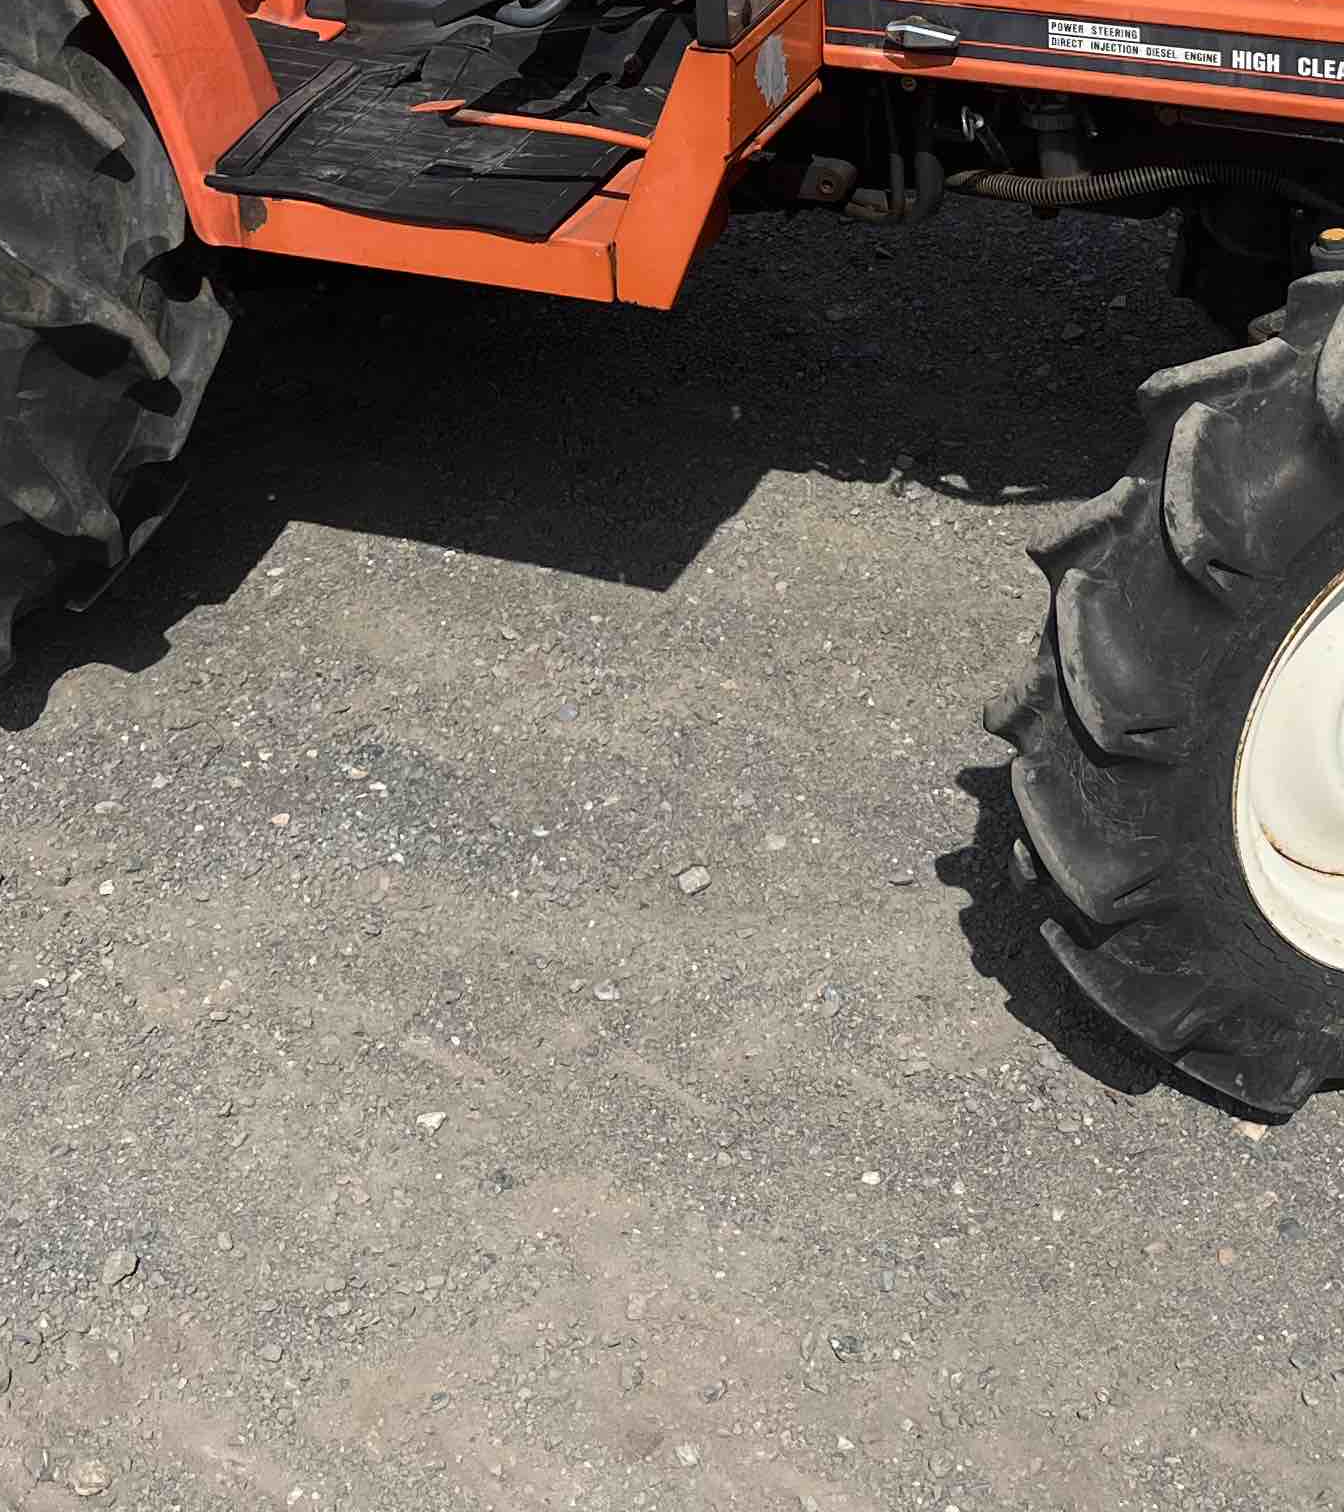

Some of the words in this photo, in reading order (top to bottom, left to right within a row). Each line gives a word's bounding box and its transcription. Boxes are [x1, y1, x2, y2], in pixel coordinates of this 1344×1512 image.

[1051, 21, 1084, 34] POWER
[1091, 25, 1138, 40] STEERING
[1051, 37, 1083, 48] DIRECT
[1090, 40, 1139, 55] INJECTION
[1146, 46, 1176, 59] DIESEL
[1184, 51, 1219, 64] ENGINE
[1231, 49, 1280, 73] HIGH
